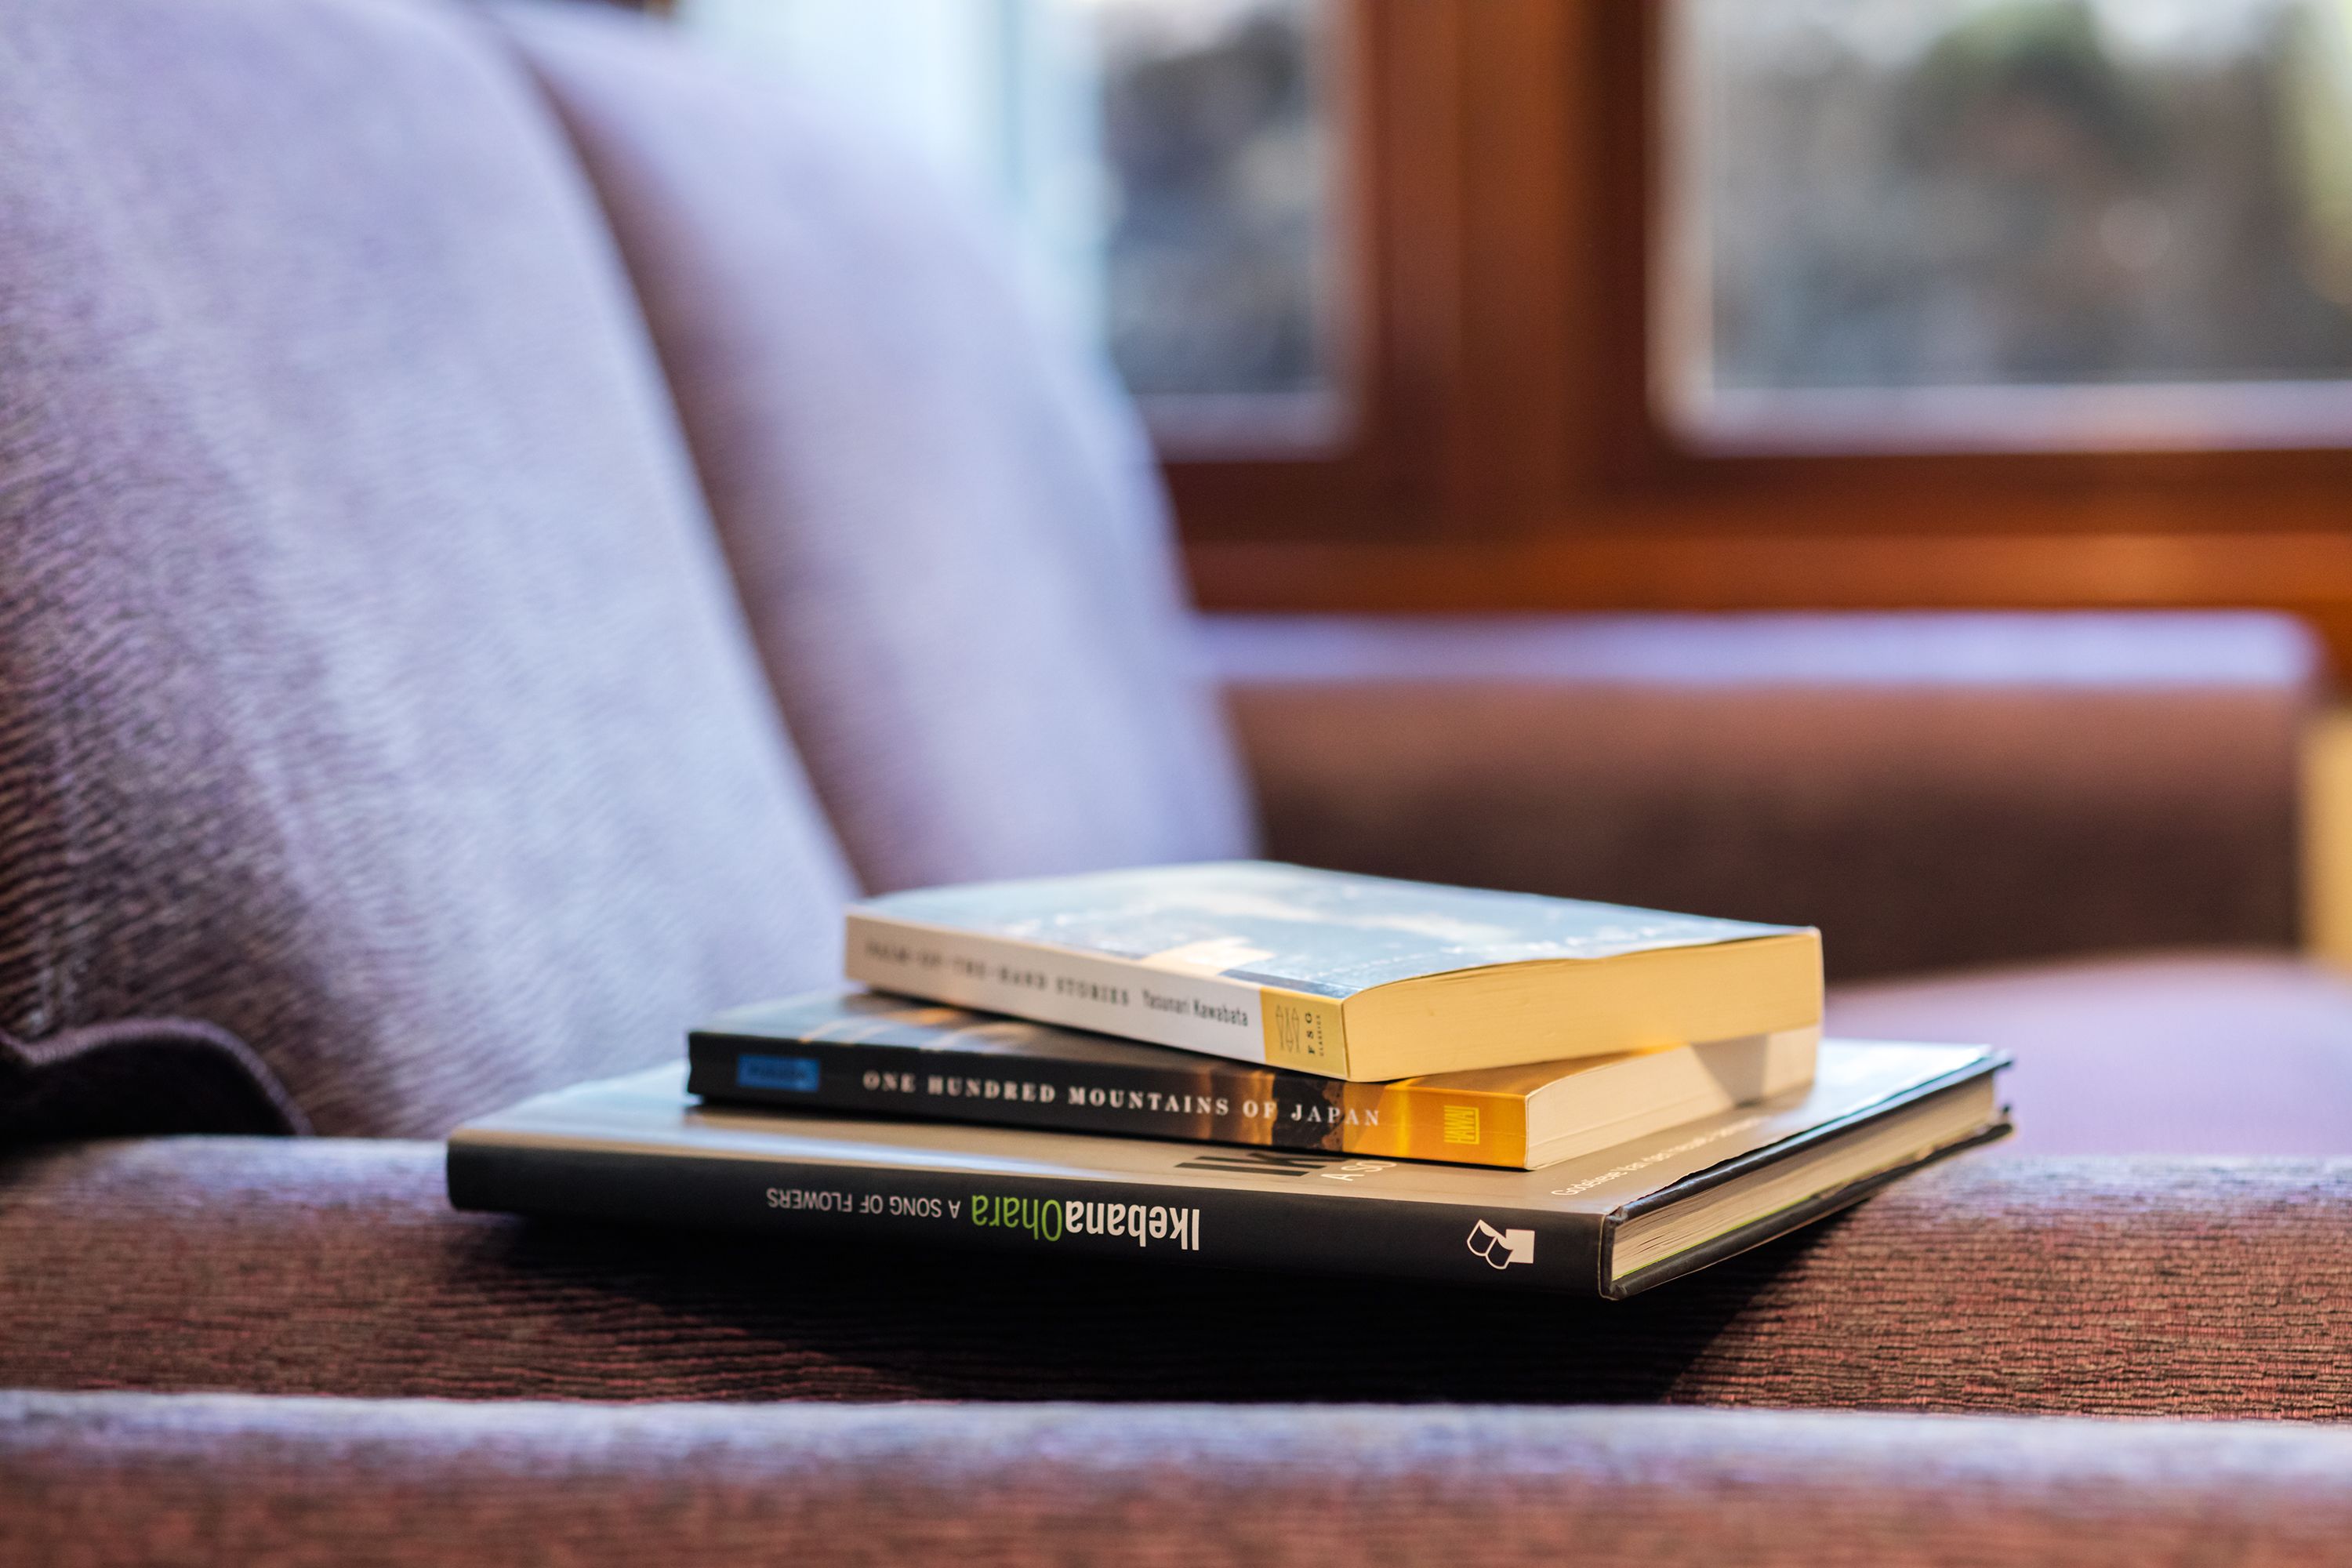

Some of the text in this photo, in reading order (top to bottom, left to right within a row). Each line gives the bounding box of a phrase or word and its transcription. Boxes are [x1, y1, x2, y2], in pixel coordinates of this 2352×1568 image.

[1193, 999, 1248, 1027] Kawabata
[863, 1070, 1380, 1127] ONE HUNDRED MOUNTAINS OF JAPAN
[766, 1188, 853, 1212] FLOWERS
[859, 1194, 884, 1214] OF
[890, 1196, 942, 1218] SONG
[948, 1200, 961, 1219] A
